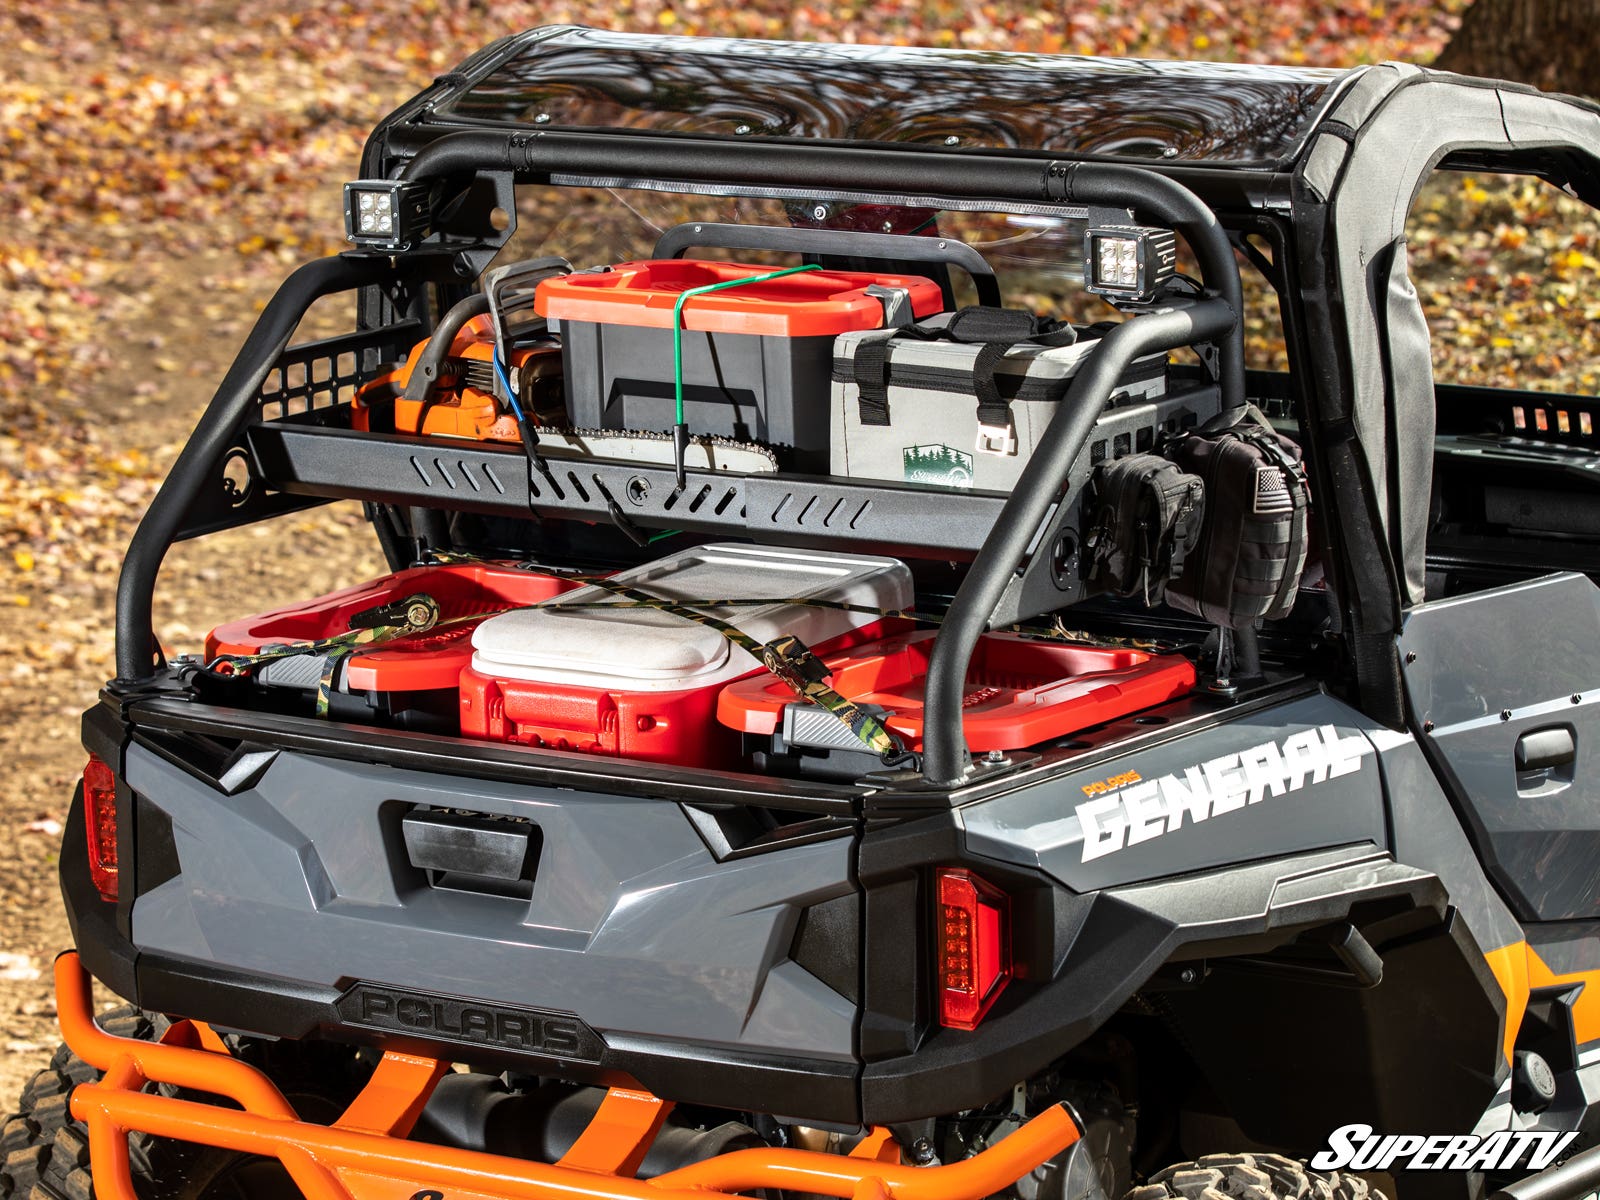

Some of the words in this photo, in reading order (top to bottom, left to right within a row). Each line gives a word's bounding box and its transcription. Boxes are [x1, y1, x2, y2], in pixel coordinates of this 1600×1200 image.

[1075, 724, 1363, 863] GENERAL
[1081, 769, 1143, 797] POLARIS
[362, 991, 579, 1054] POLARIS
